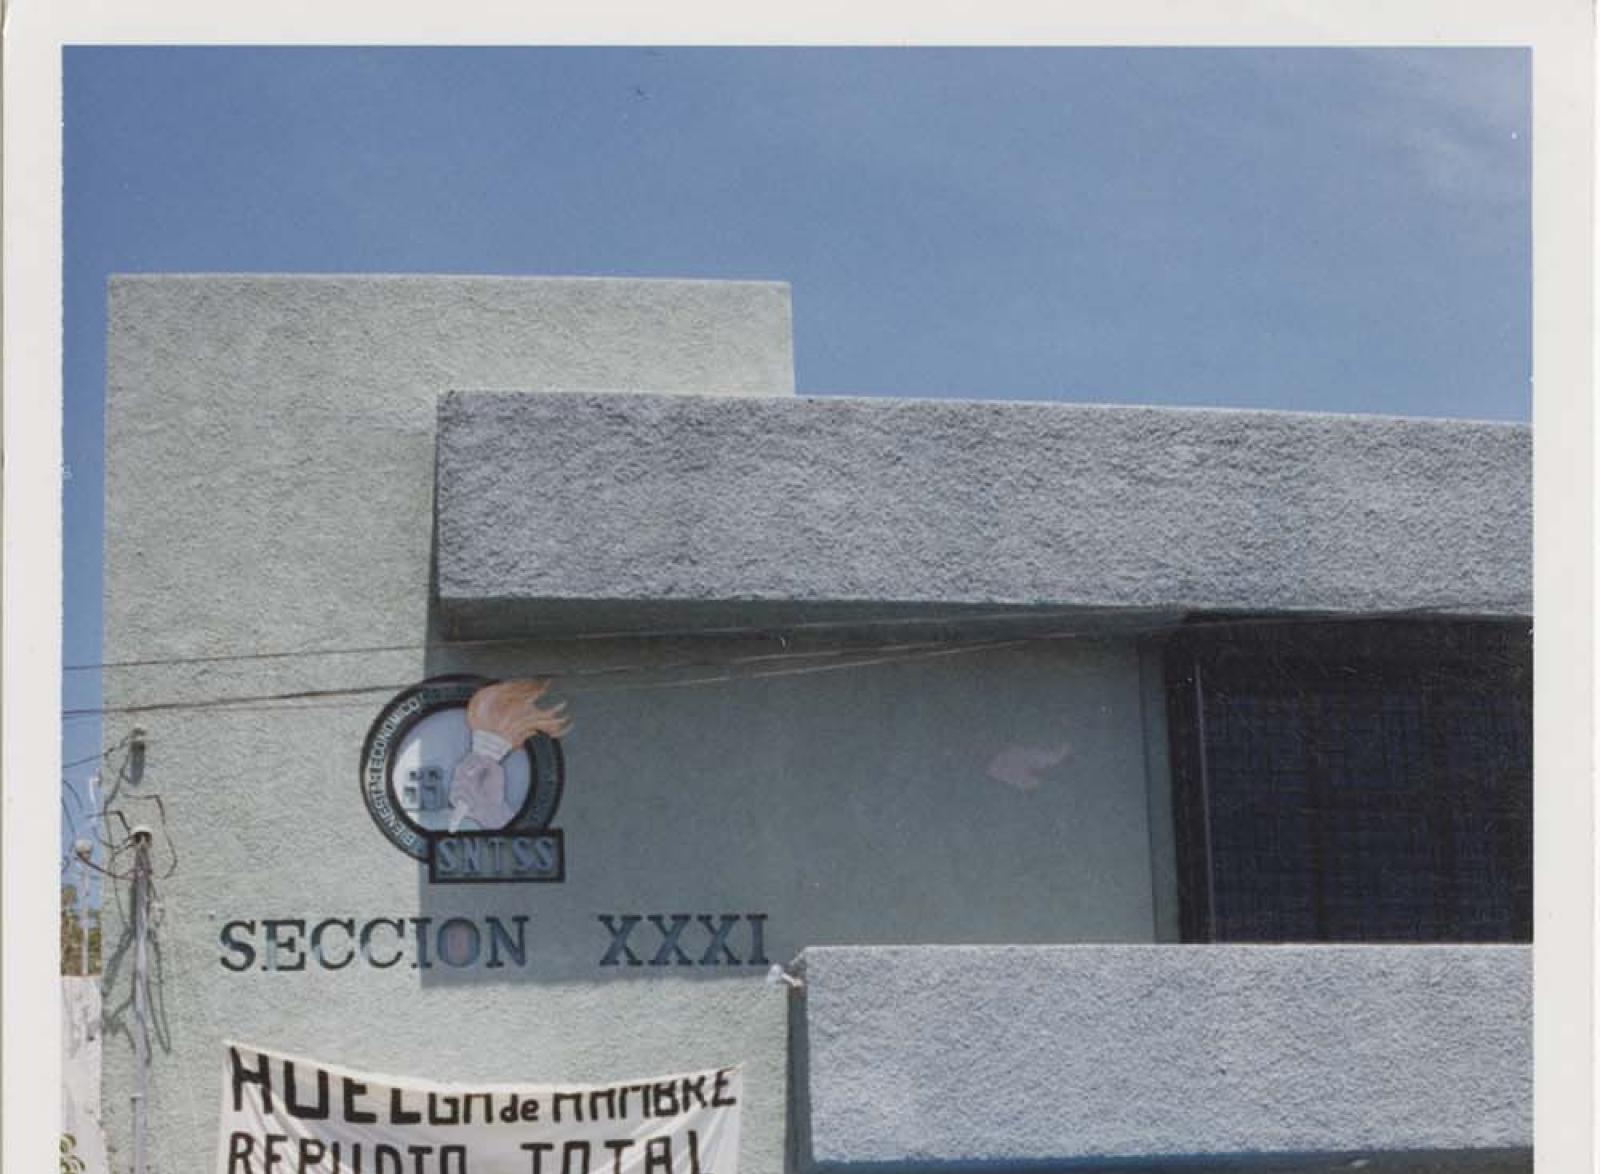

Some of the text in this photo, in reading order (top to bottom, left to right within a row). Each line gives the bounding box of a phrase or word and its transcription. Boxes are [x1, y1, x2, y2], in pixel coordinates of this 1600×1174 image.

[437, 837, 555, 872] SNTSS
[219, 914, 769, 972] SECCION XXXI
[500, 1093, 540, 1123] de
